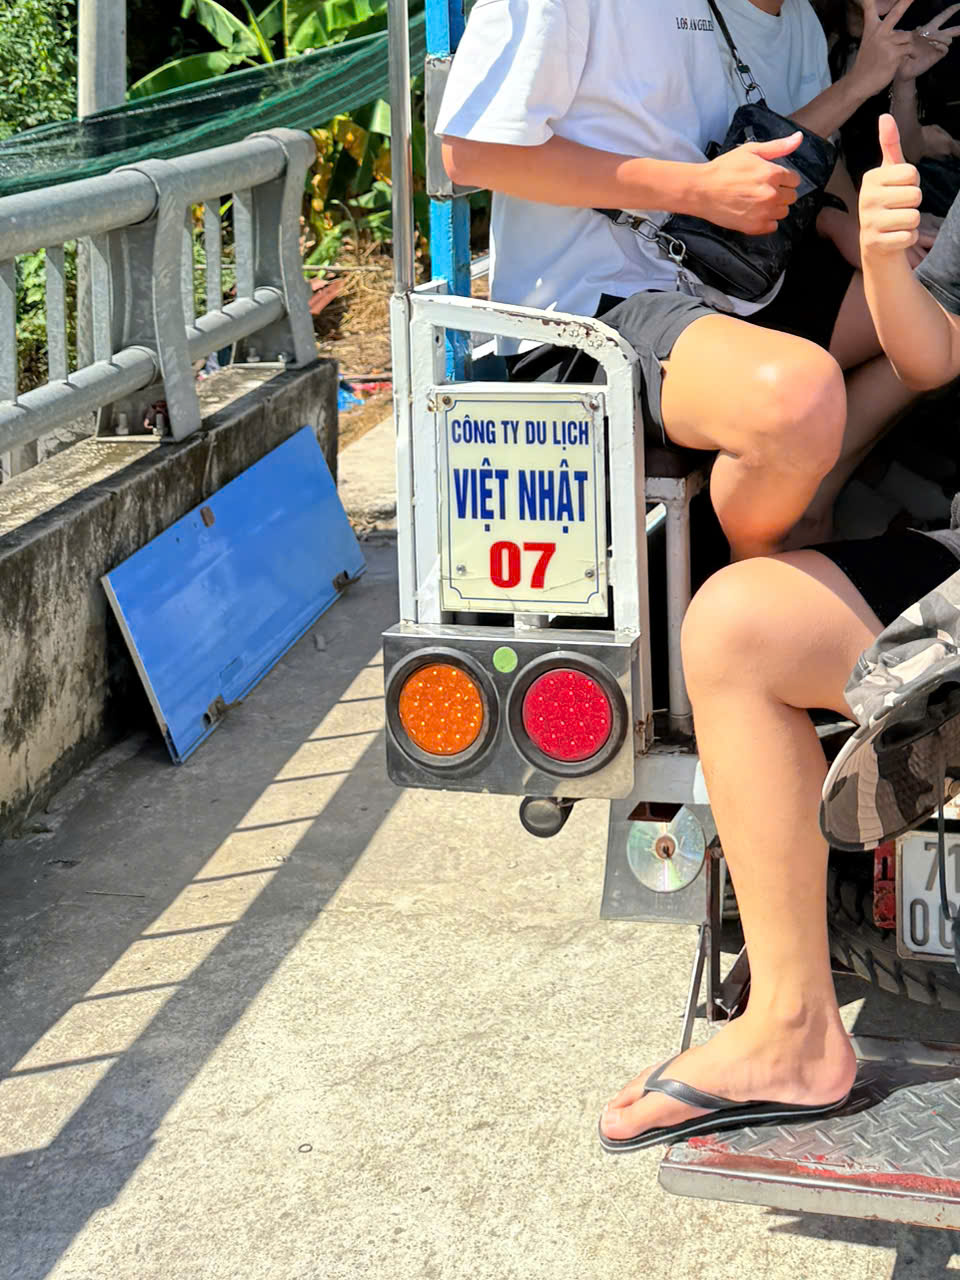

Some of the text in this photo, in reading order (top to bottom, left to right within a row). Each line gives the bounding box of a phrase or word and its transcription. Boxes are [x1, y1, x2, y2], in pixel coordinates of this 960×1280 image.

[676, 17, 689, 30] LOS
[451, 414, 589, 451] CÔNG TY DU LỊCH
[453, 457, 588, 534] VIỆT NHẬT
[489, 540, 557, 589] 07
